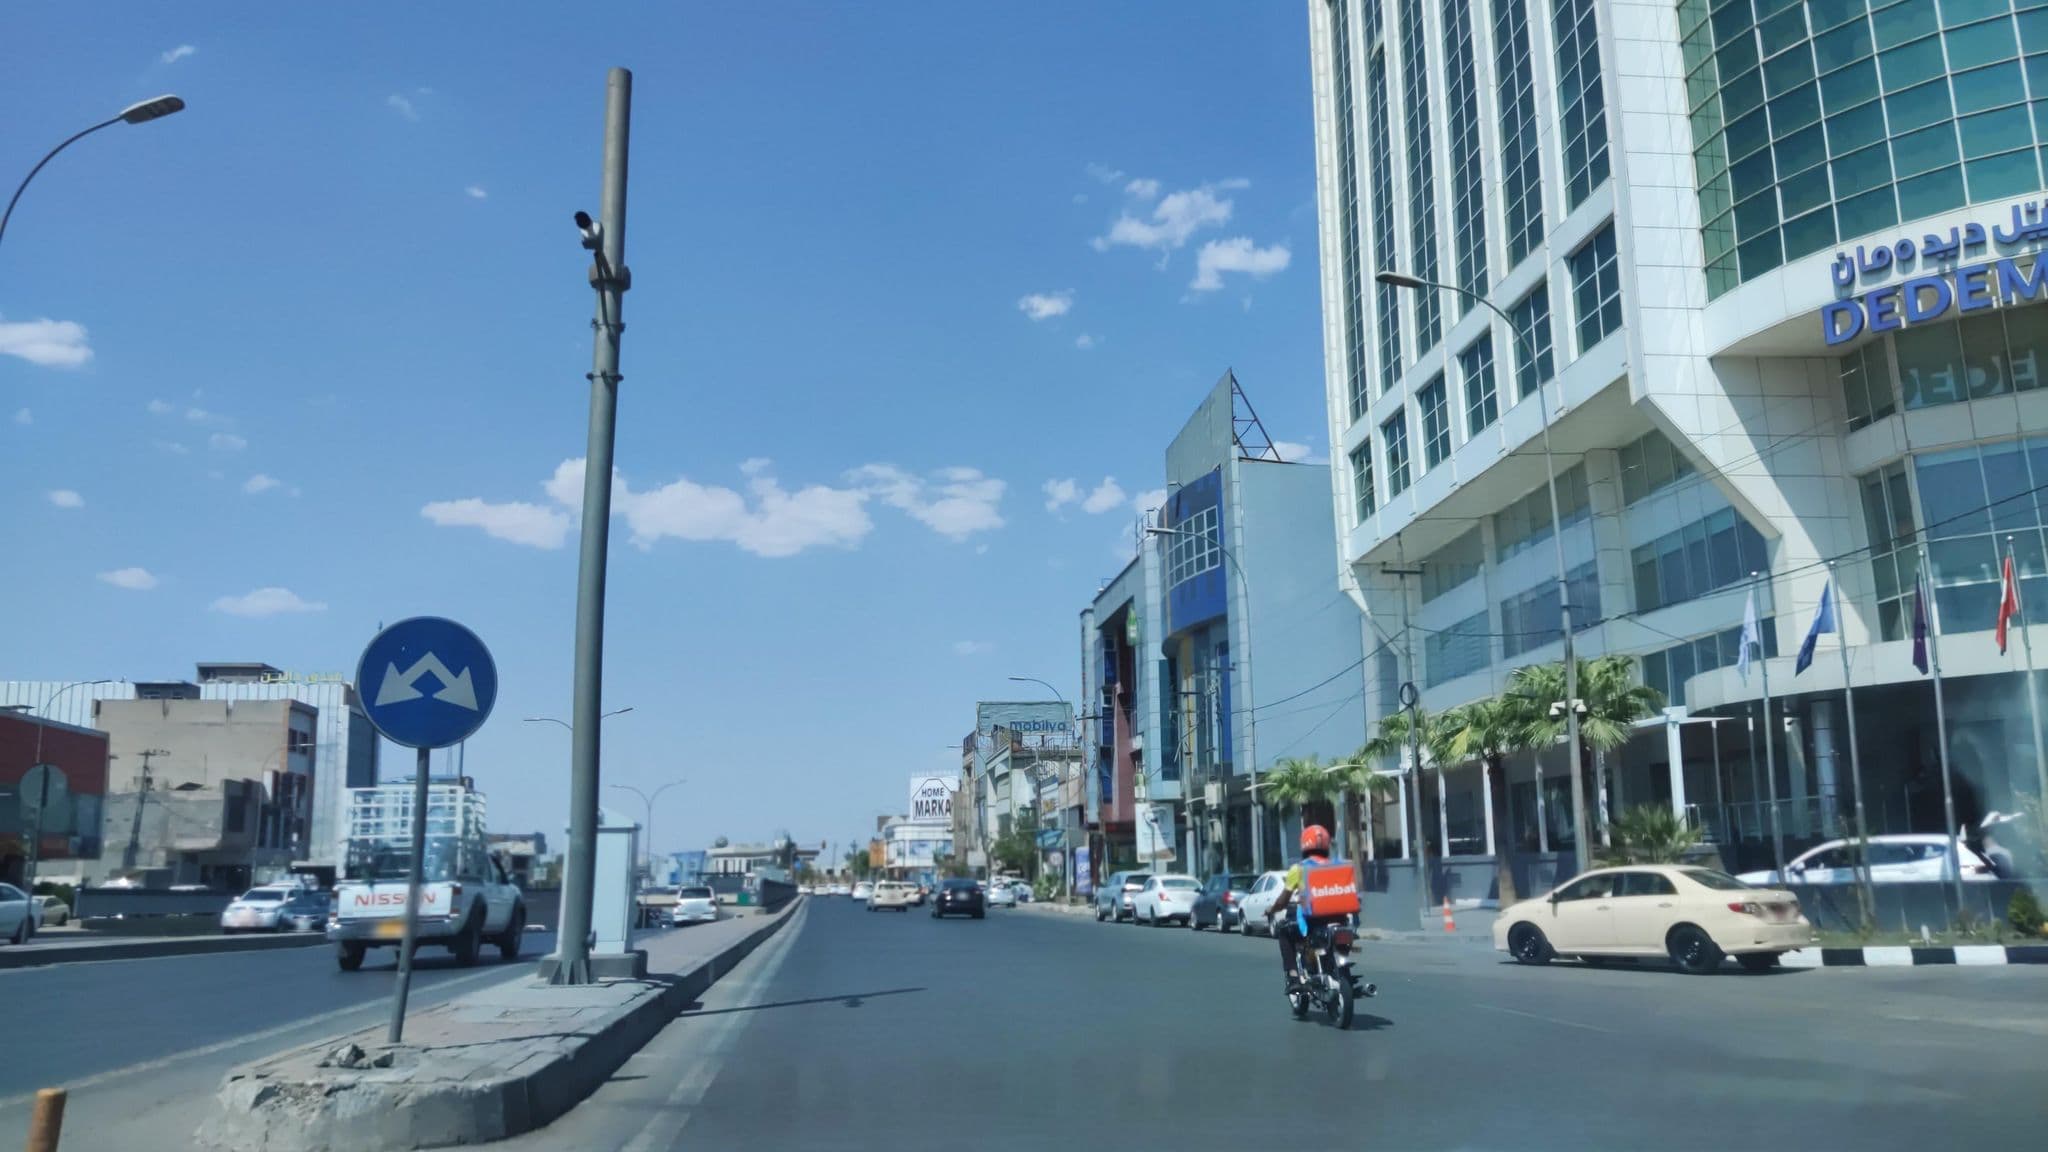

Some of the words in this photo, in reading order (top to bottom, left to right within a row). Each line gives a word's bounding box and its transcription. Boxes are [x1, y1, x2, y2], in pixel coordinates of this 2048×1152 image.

[1821, 249, 2048, 346] DEDEM
[1009, 720, 1066, 732] mobilya
[921, 787, 945, 798] HOME
[915, 798, 953, 817] MARKA
[1311, 882, 1356, 897] talabat
[355, 892, 437, 908] NISSN
